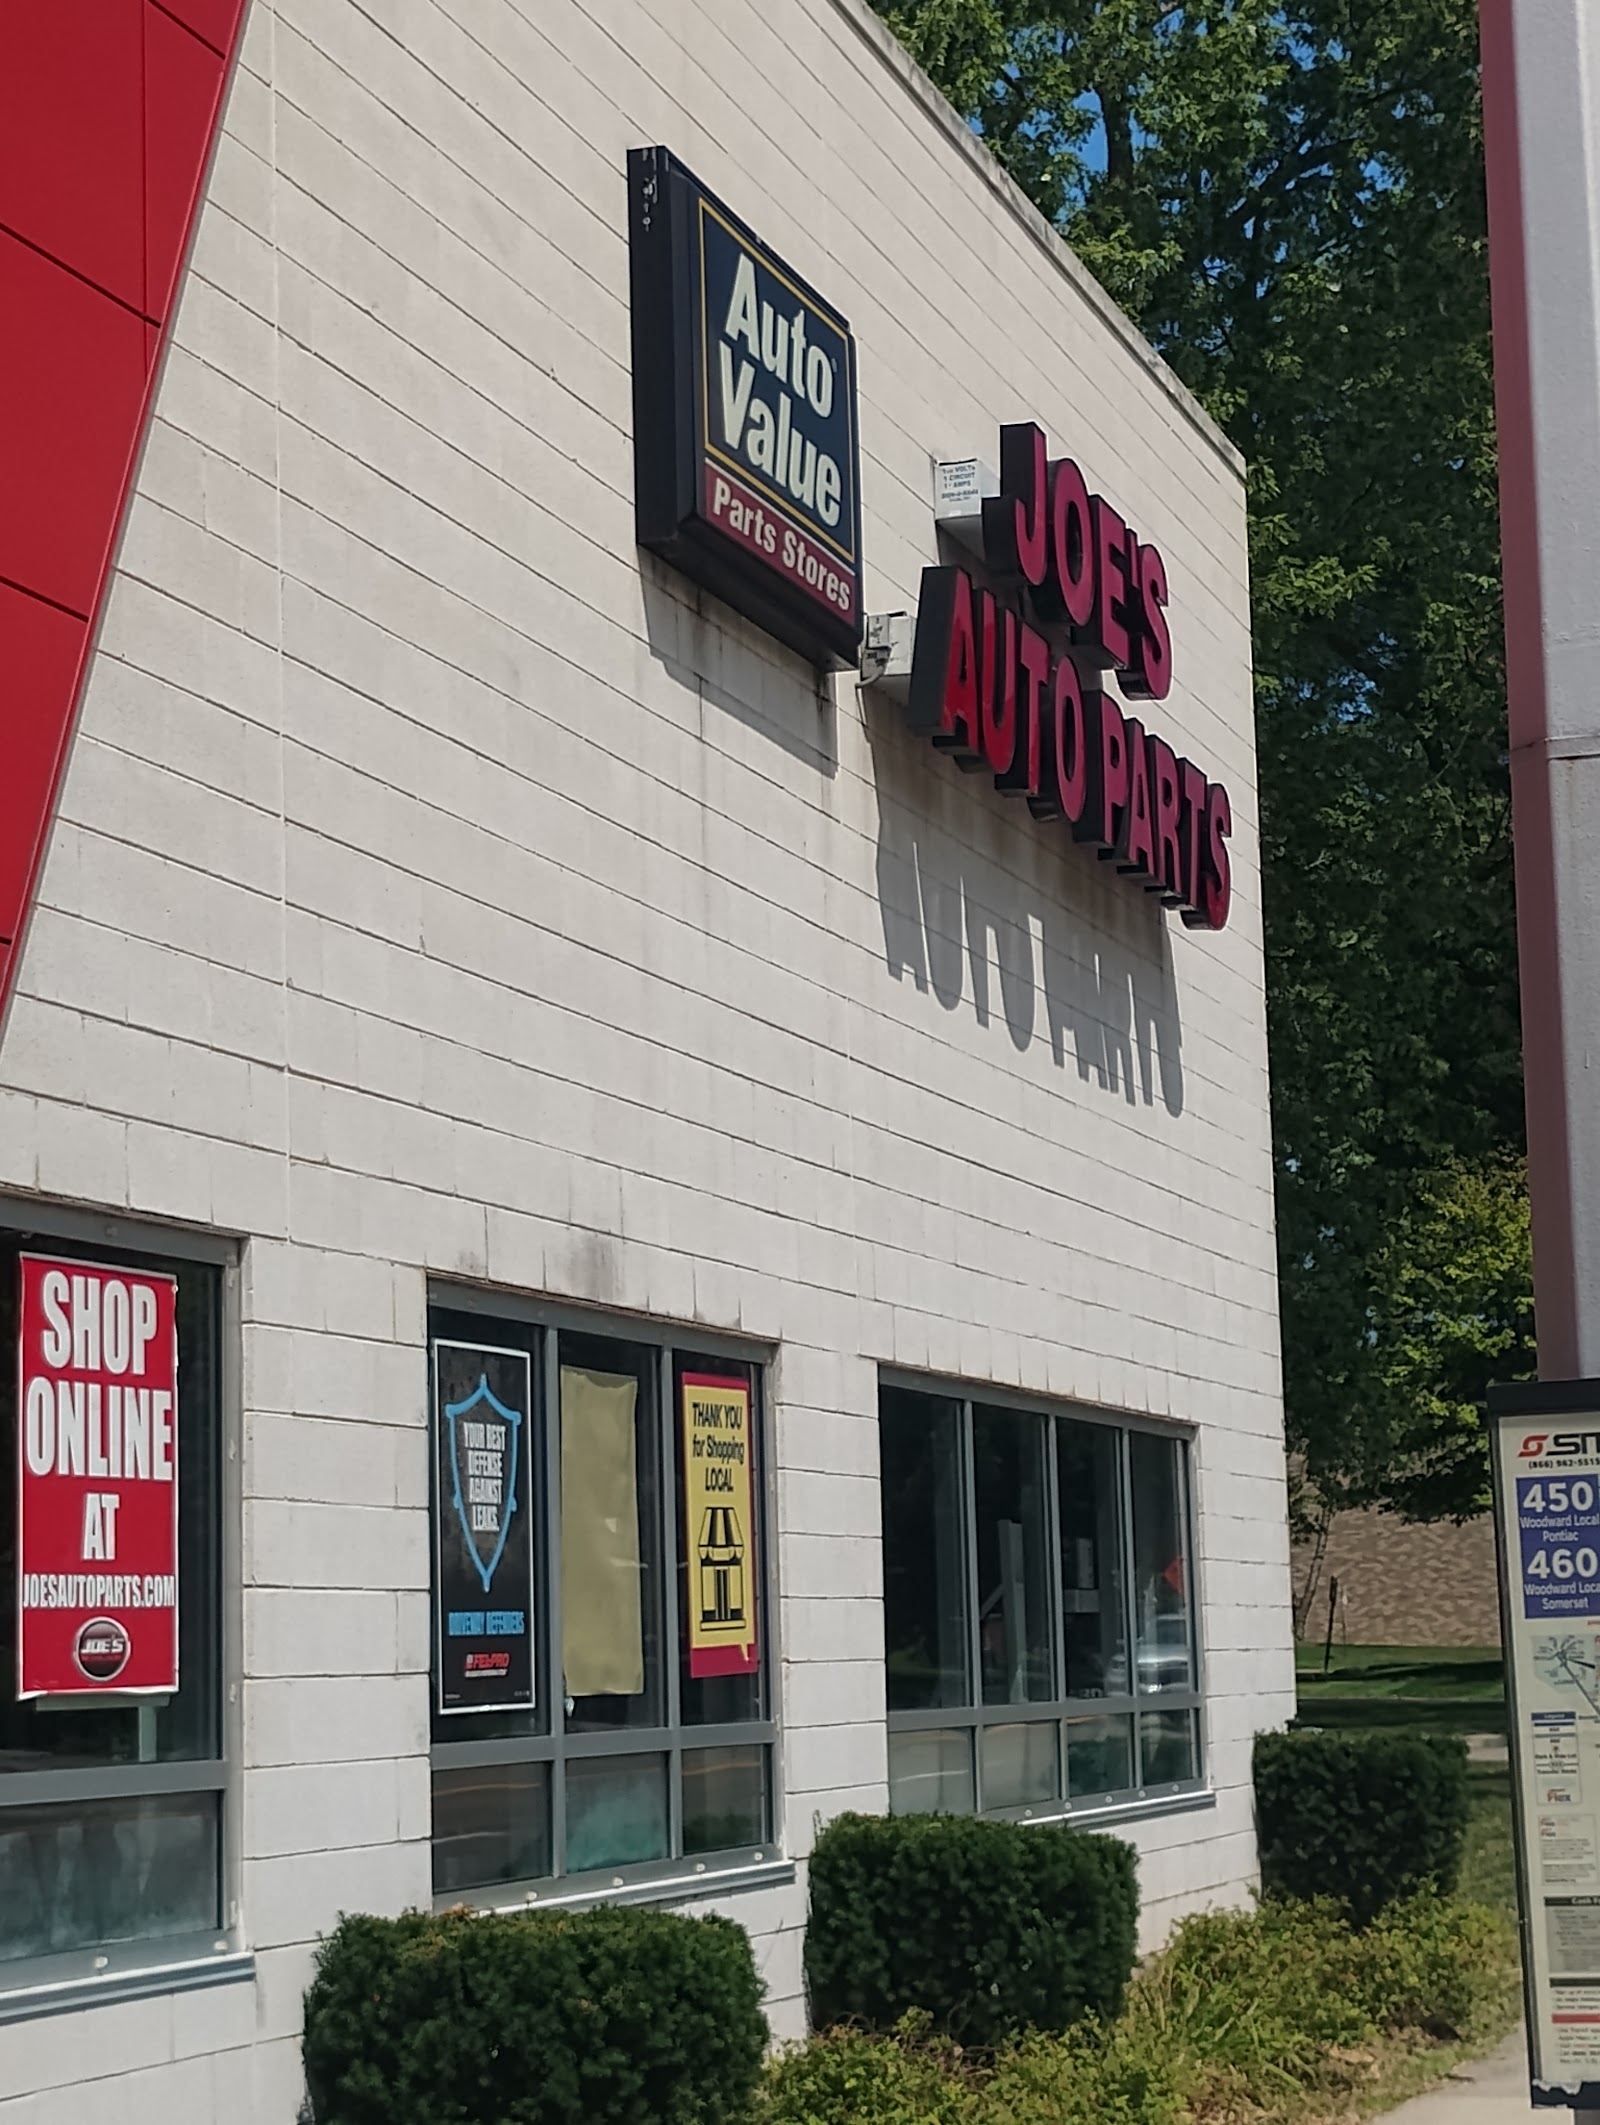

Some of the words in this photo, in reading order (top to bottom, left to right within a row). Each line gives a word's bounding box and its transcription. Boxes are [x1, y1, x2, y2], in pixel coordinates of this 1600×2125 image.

[724, 252, 835, 419] Auto
[719, 338, 841, 528] Value
[712, 477, 777, 554] Parts
[782, 530, 851, 612] Stores
[1005, 424, 1172, 701] JOE'S
[938, 567, 1087, 823] AUTO
[1098, 692, 1232, 931] PARTS
[41, 1270, 158, 1376] SHOP
[26, 1375, 173, 1482] ONLINE
[692, 1402, 723, 1428] THANK
[724, 1404, 743, 1430] YOU
[463, 1421, 485, 1450] YOUR
[486, 1423, 506, 1452] BEST
[692, 1433, 706, 1458] for
[706, 1434, 745, 1466] Shopping
[467, 1450, 503, 1478] DEFENSE
[704, 1466, 734, 1493] LOCAL
[1528, 1460, 1553, 1470] (866)
[468, 1476, 503, 1504] AGAINST
[1522, 1480, 1595, 1514] 450
[81, 1492, 121, 1561] AT
[1519, 1514, 1572, 1529] Woodward
[1574, 1513, 1600, 1526] Local
[1542, 1529, 1580, 1542] Pontiac
[1527, 1547, 1598, 1579] 460
[23, 1573, 175, 1609] JOESAUTOPARTS.COM
[1524, 1581, 1577, 1596] Woodward
[1541, 1596, 1589, 1610] Somerset
[80, 1633, 125, 1654] JOE'S
